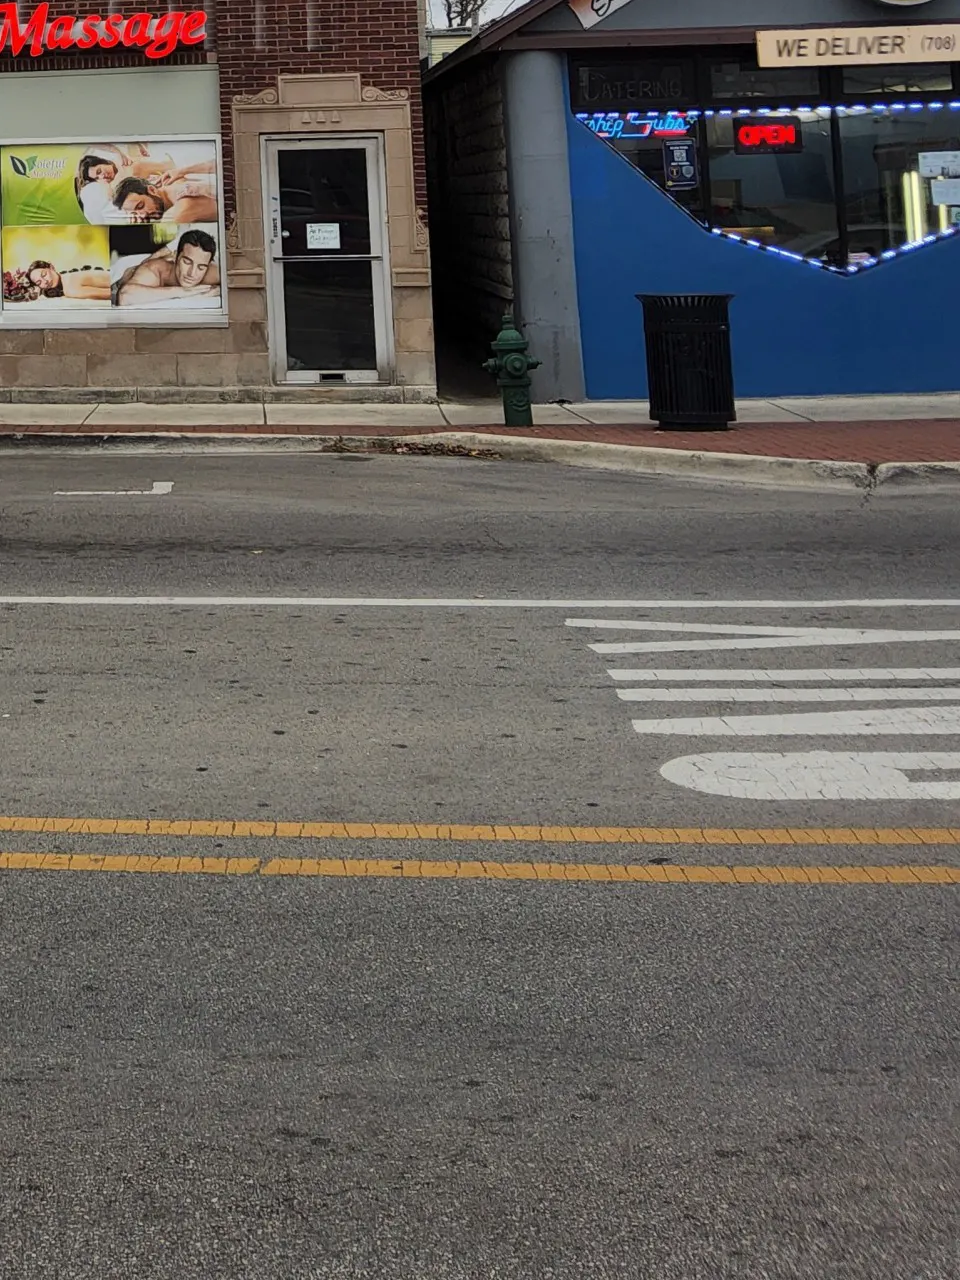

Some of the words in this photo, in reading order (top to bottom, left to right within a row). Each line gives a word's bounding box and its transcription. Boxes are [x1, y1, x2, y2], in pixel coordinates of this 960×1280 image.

[776, 38, 809, 58] WE
[815, 35, 906, 57] DELIVER
[921, 34, 955, 52] (708)
[738, 125, 796, 146] OPEN
